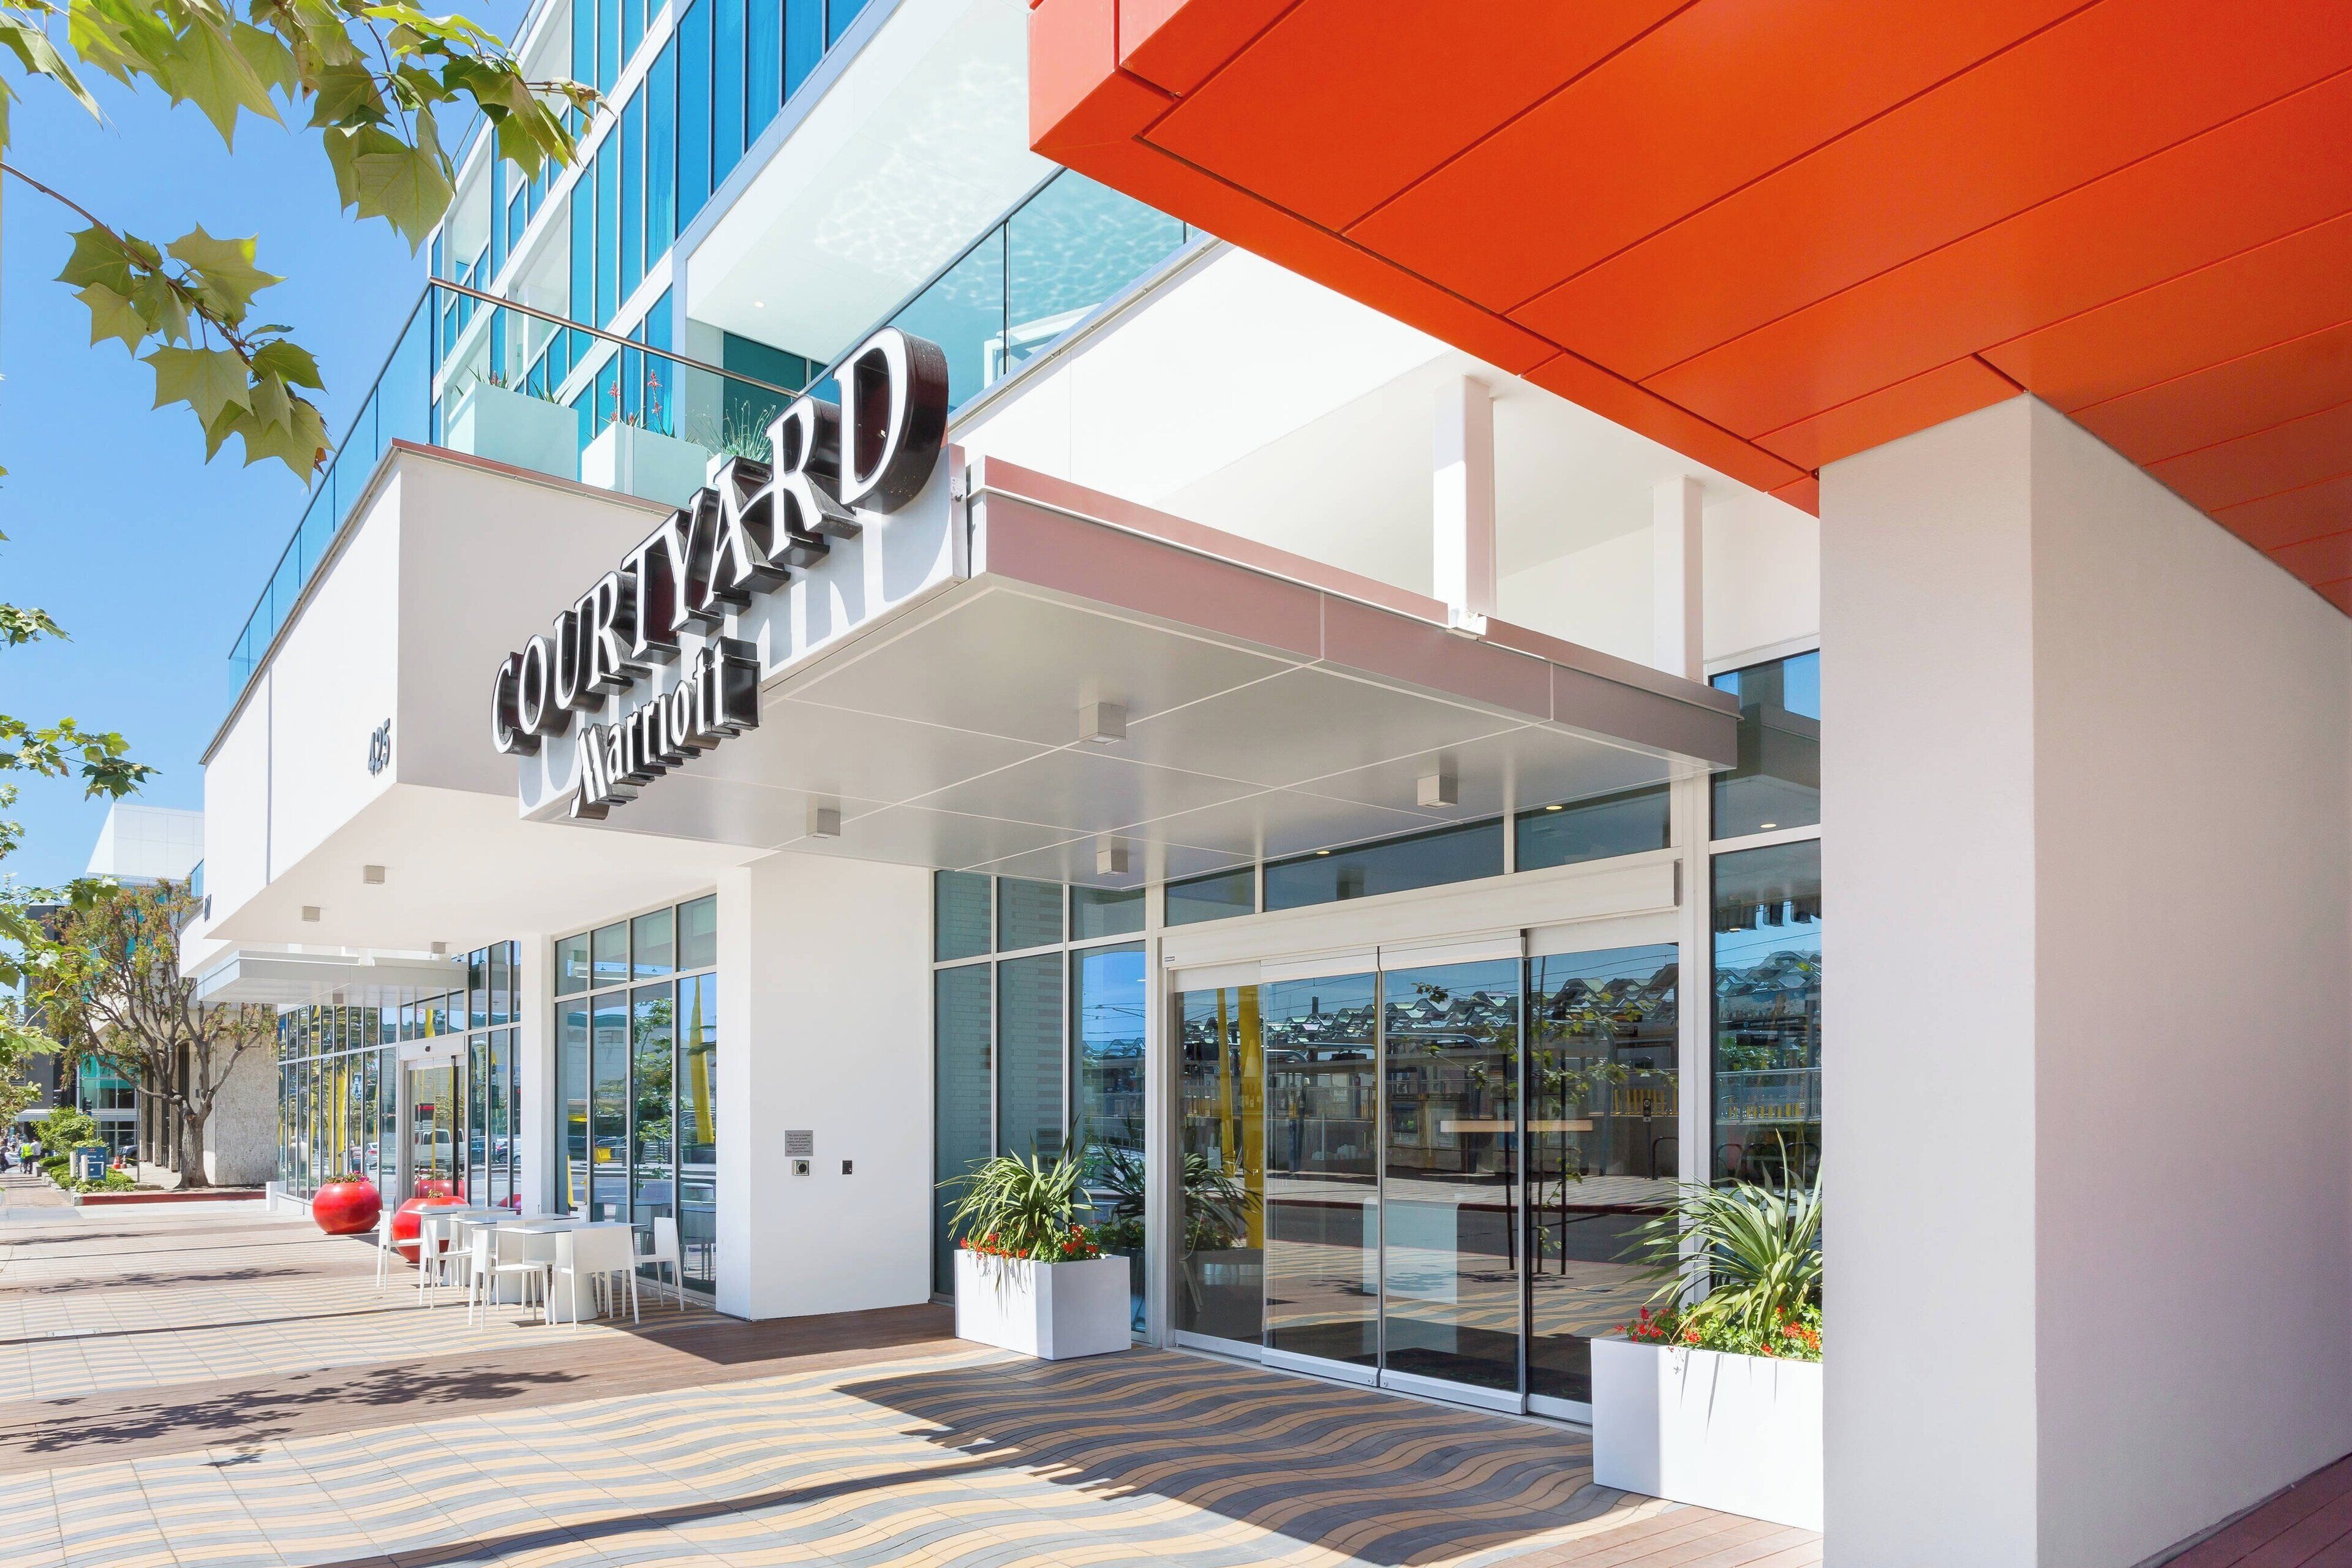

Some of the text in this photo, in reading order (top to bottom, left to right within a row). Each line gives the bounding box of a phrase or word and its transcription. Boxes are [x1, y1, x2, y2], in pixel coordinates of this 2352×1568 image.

[491, 325, 913, 754] COURTYARD
[368, 718, 390, 777] 425
[569, 636, 726, 818] Marriott
